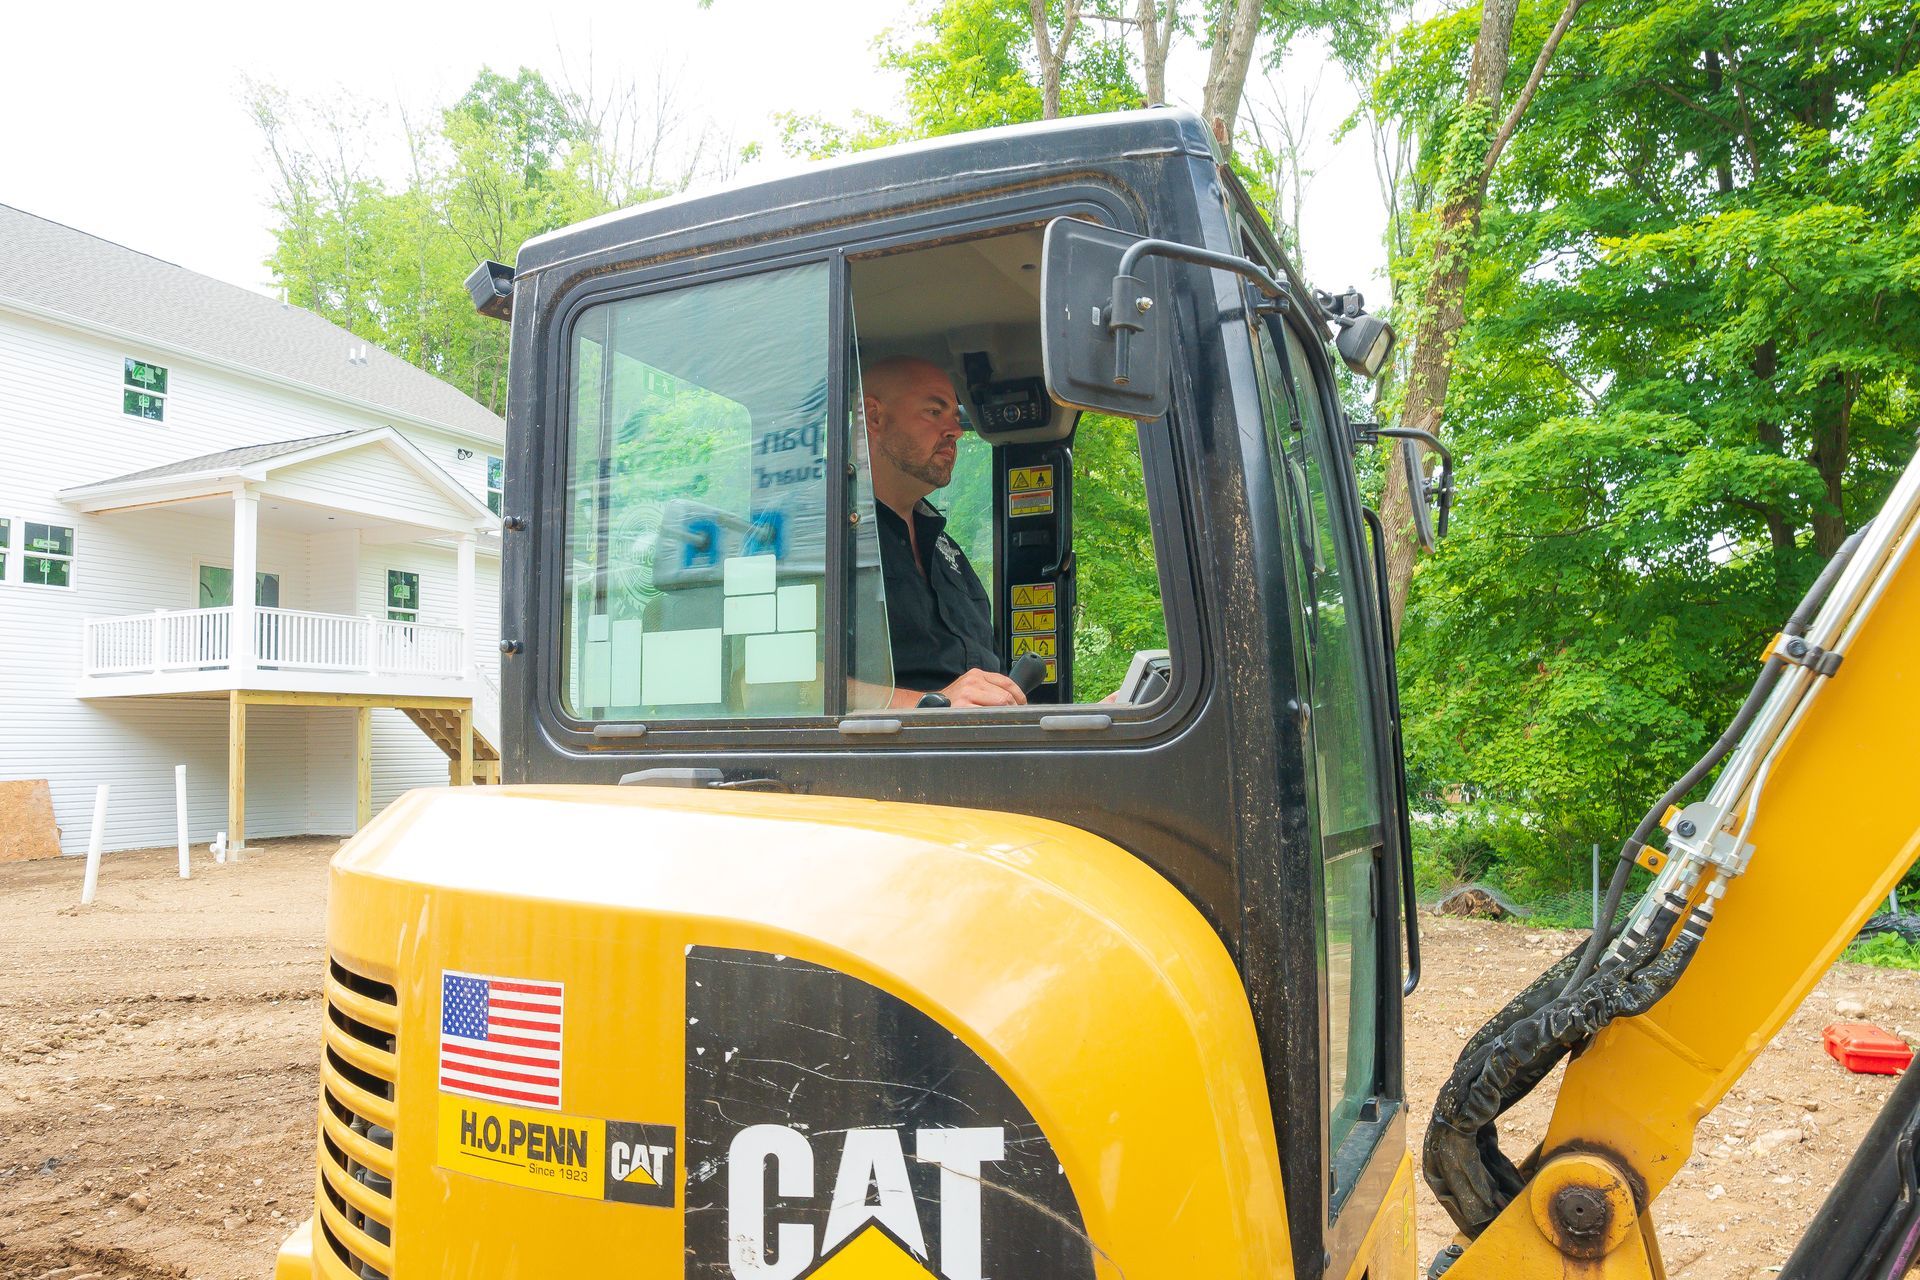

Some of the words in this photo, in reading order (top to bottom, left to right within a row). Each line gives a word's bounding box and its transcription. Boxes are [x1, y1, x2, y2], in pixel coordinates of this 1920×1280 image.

[528, 1163, 555, 1177] Since
[559, 1168, 588, 1183] 1923
[728, 1123, 1005, 1280] CAT
